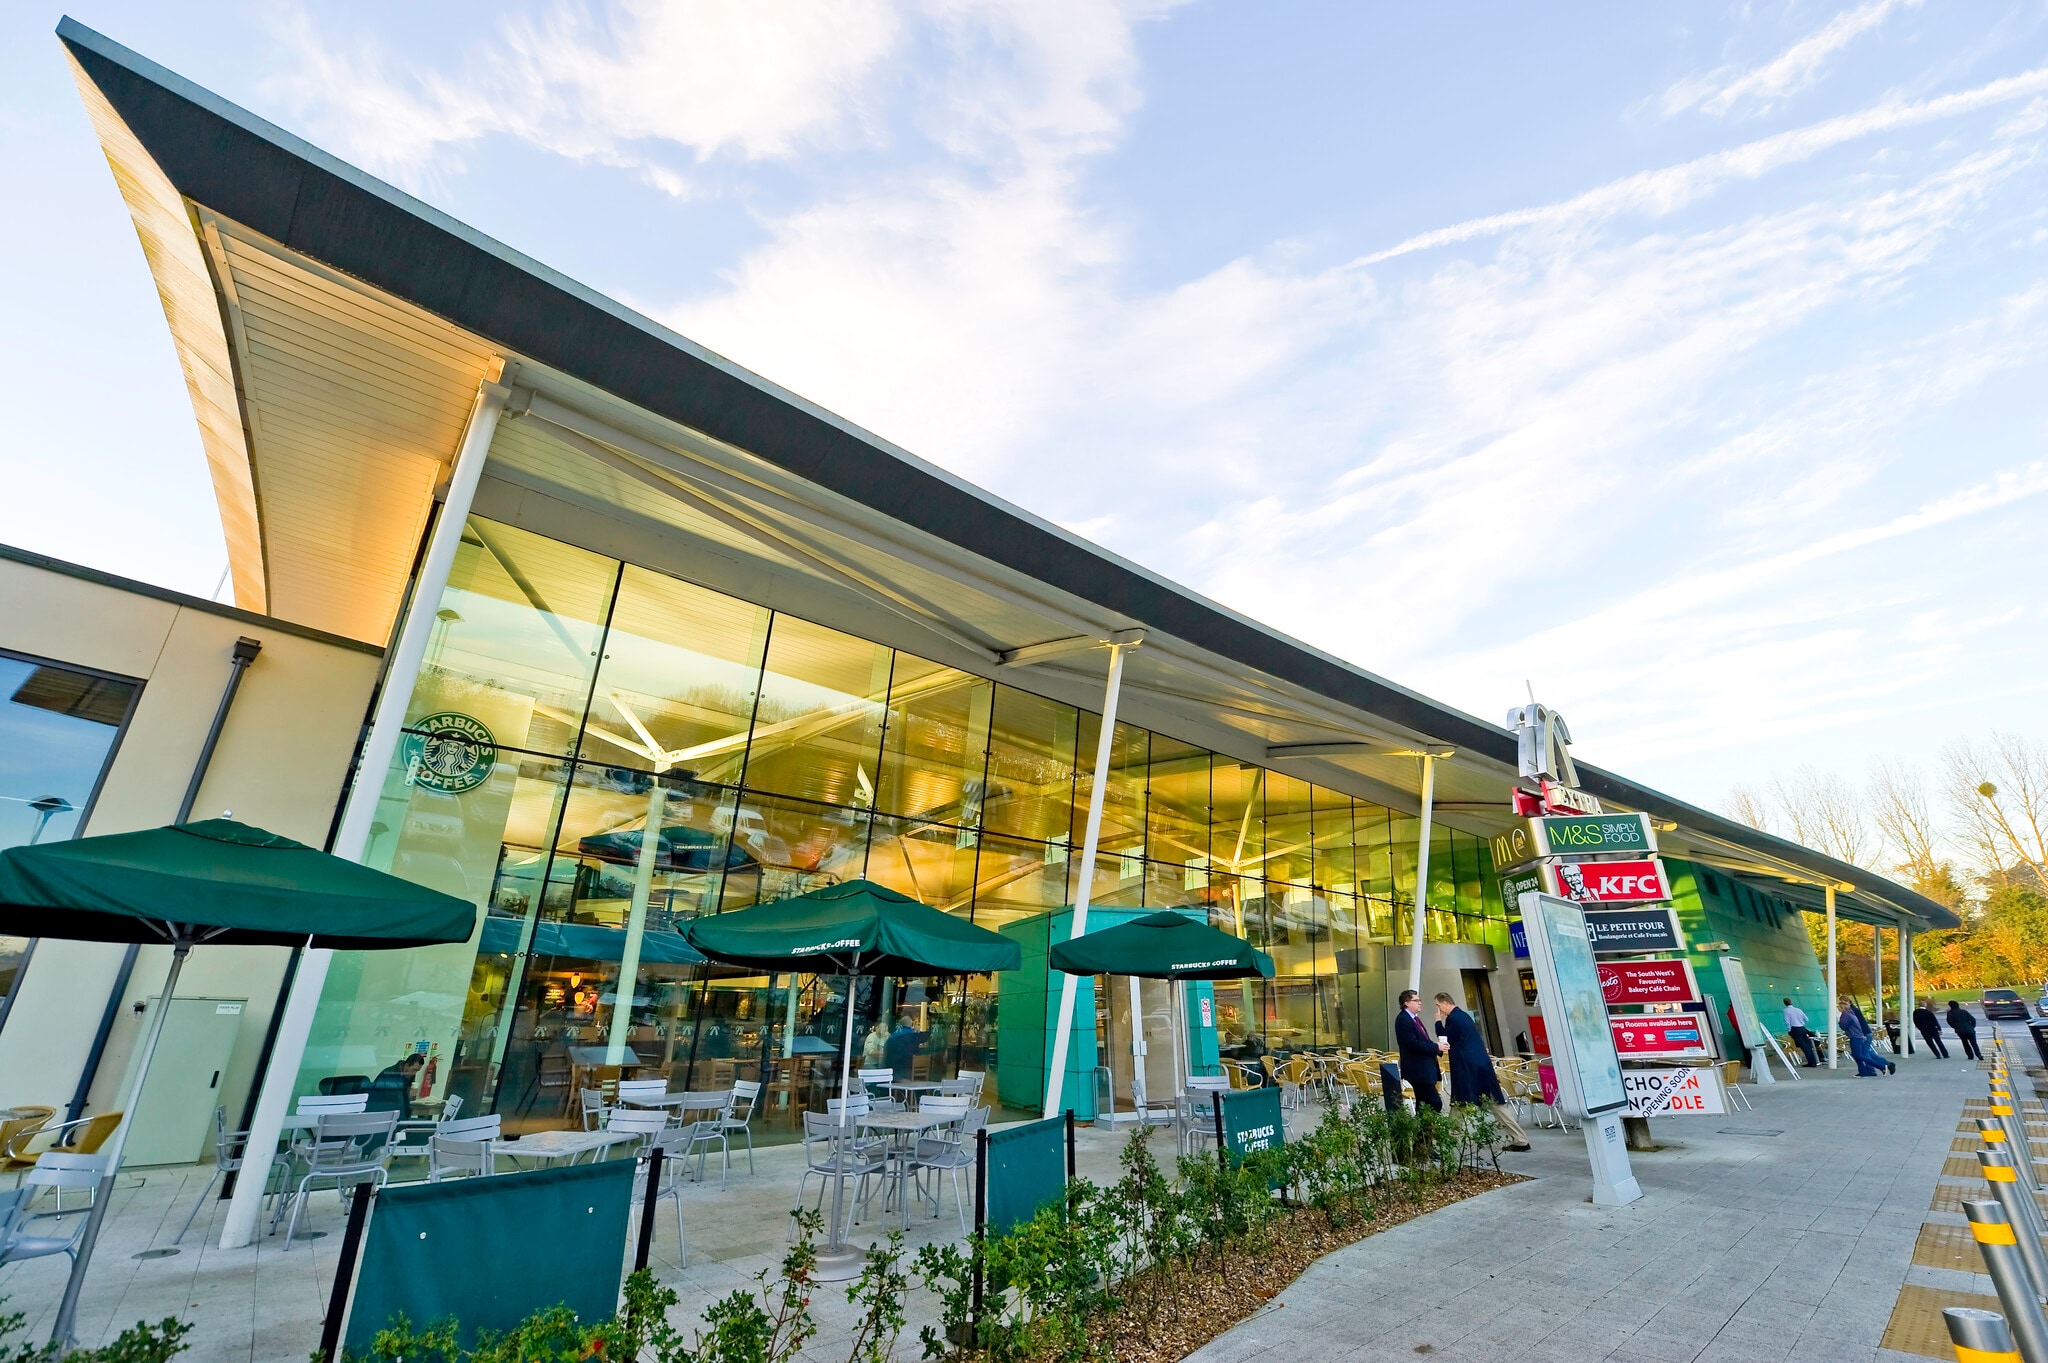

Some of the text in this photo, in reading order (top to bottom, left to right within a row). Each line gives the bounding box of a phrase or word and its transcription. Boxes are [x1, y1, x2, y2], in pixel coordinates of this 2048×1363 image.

[416, 764, 476, 789] COFFEE
[1549, 823, 1637, 846] M&S SIMPLY
[1604, 832, 1640, 843] FOOD
[1515, 879, 1531, 891] OPEN
[1531, 877, 1539, 887] 24
[1599, 875, 1657, 894] KFC
[1596, 921, 1665, 932] LE PETIT FOUR
[1628, 986, 1648, 994] Bakery
[1649, 1019, 1677, 1027] available
[1624, 1075, 1699, 1091] CHON
[1642, 1086, 1673, 1118] OPENING
[1669, 1067, 1691, 1088] SOON
